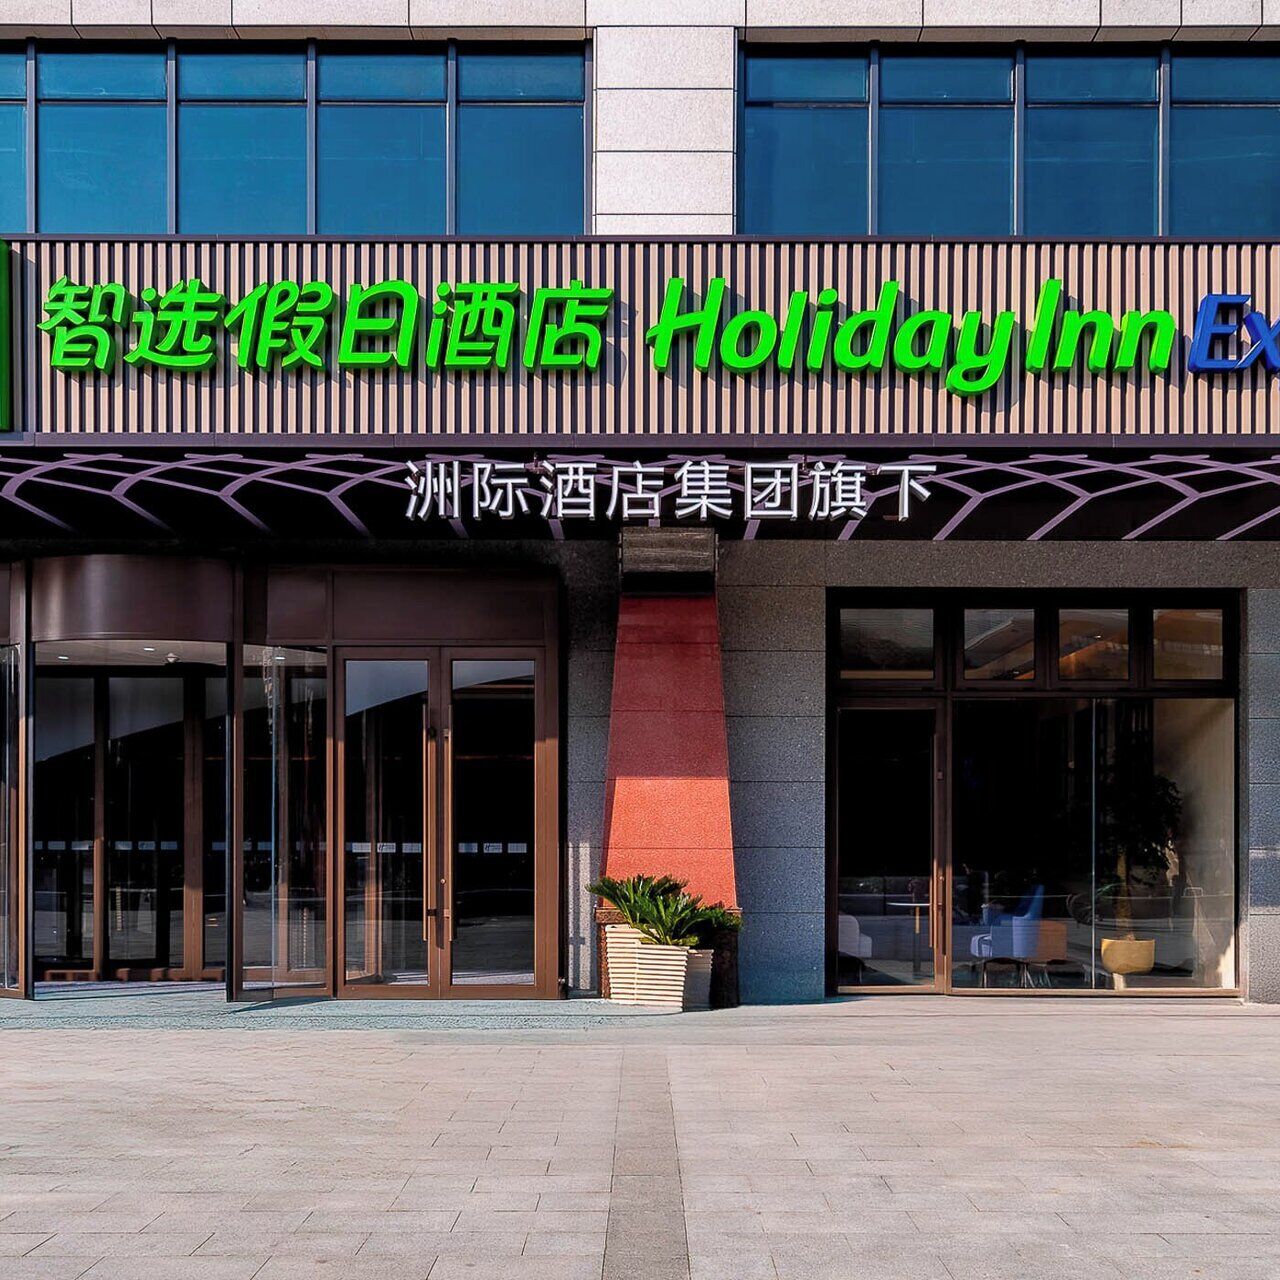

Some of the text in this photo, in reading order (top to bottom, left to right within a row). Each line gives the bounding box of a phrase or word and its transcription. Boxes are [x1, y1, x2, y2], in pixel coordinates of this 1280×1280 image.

[37, 275, 616, 373] 智选假日酒店
[646, 277, 1015, 398] Holiday
[1024, 278, 1176, 373] Inn
[404, 460, 937, 521] 洲际酒店集团旗下
